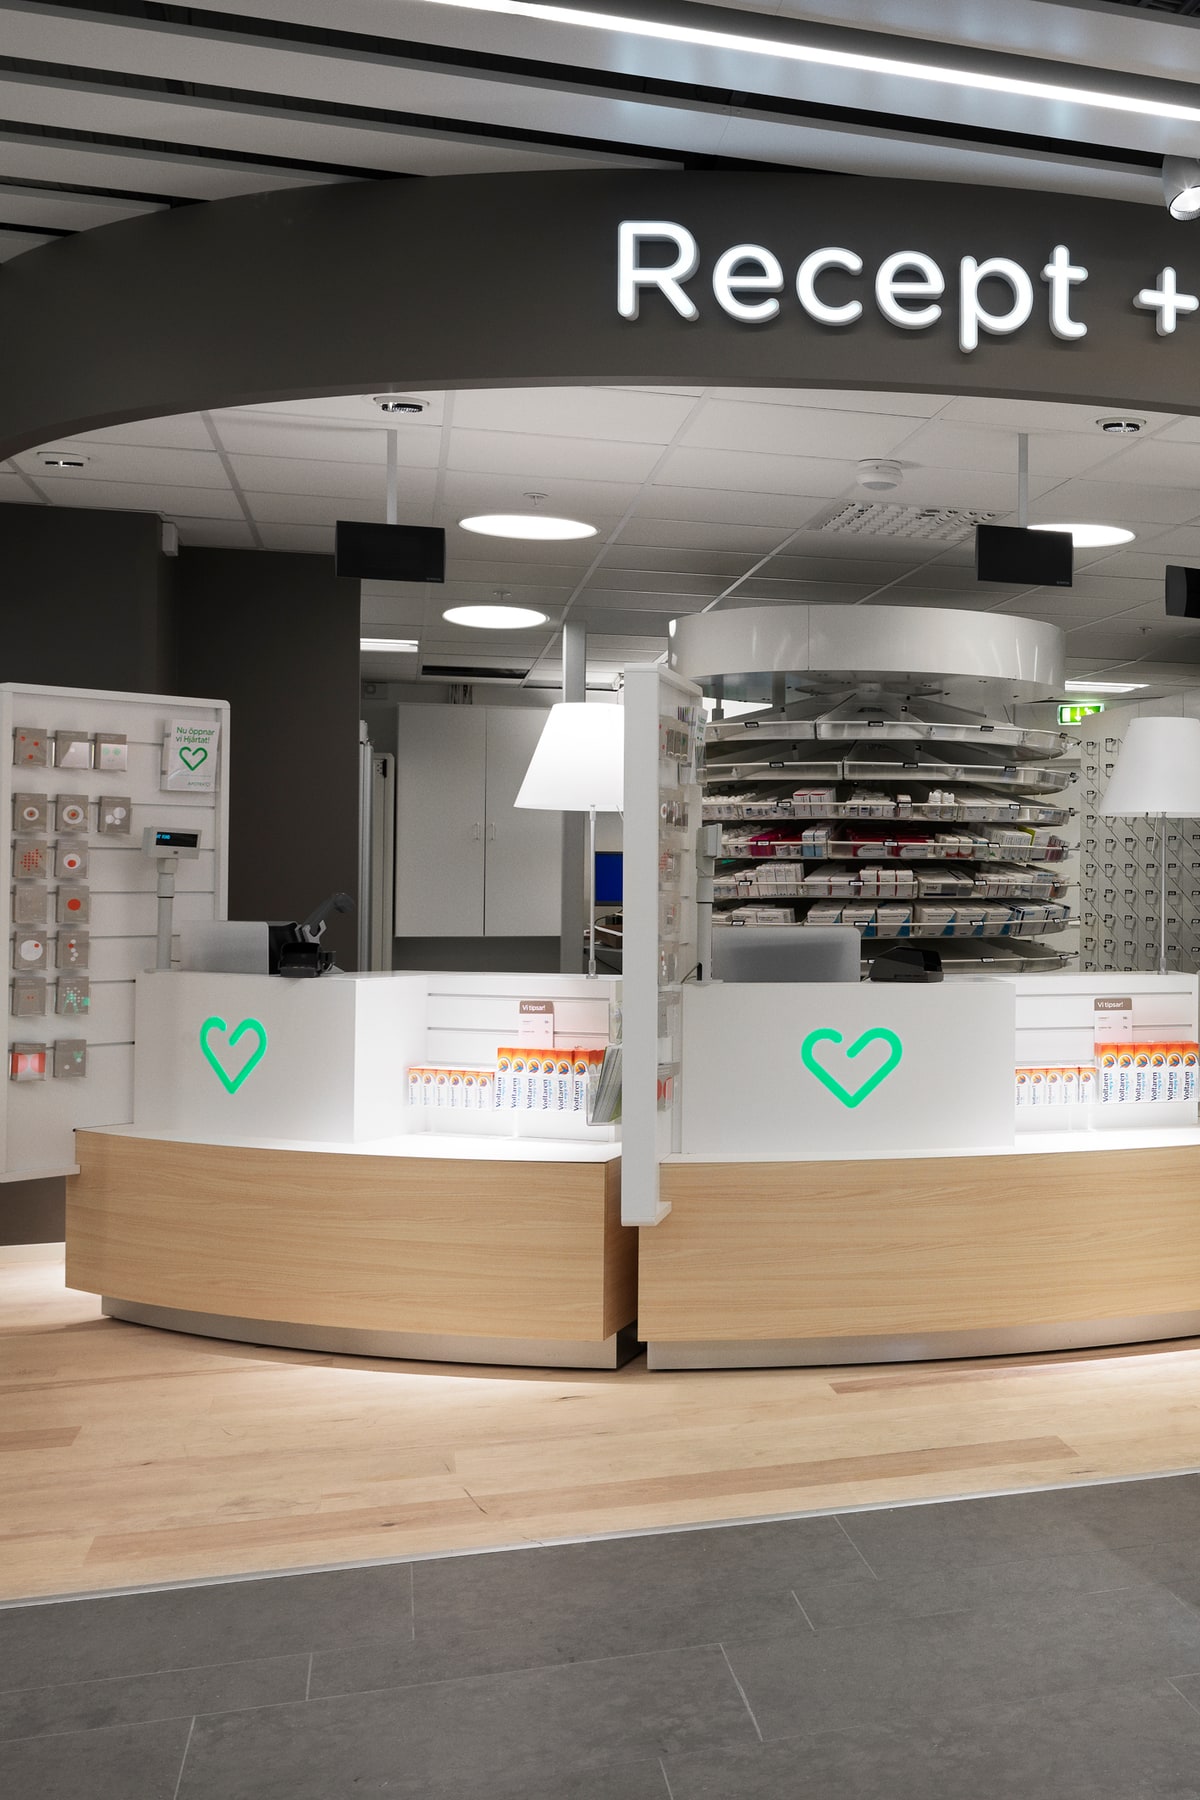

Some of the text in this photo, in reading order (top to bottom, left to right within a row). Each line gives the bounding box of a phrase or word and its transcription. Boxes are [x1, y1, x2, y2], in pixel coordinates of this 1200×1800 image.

[617, 220, 1089, 353] Recept
[1133, 266, 1199, 336] +
[176, 726, 215, 736] Nu öppnar
[529, 1004, 546, 1012] tipsar!
[1104, 1001, 1124, 1009] tipsar!
[1150, 1072, 1158, 1101] Voltaren
